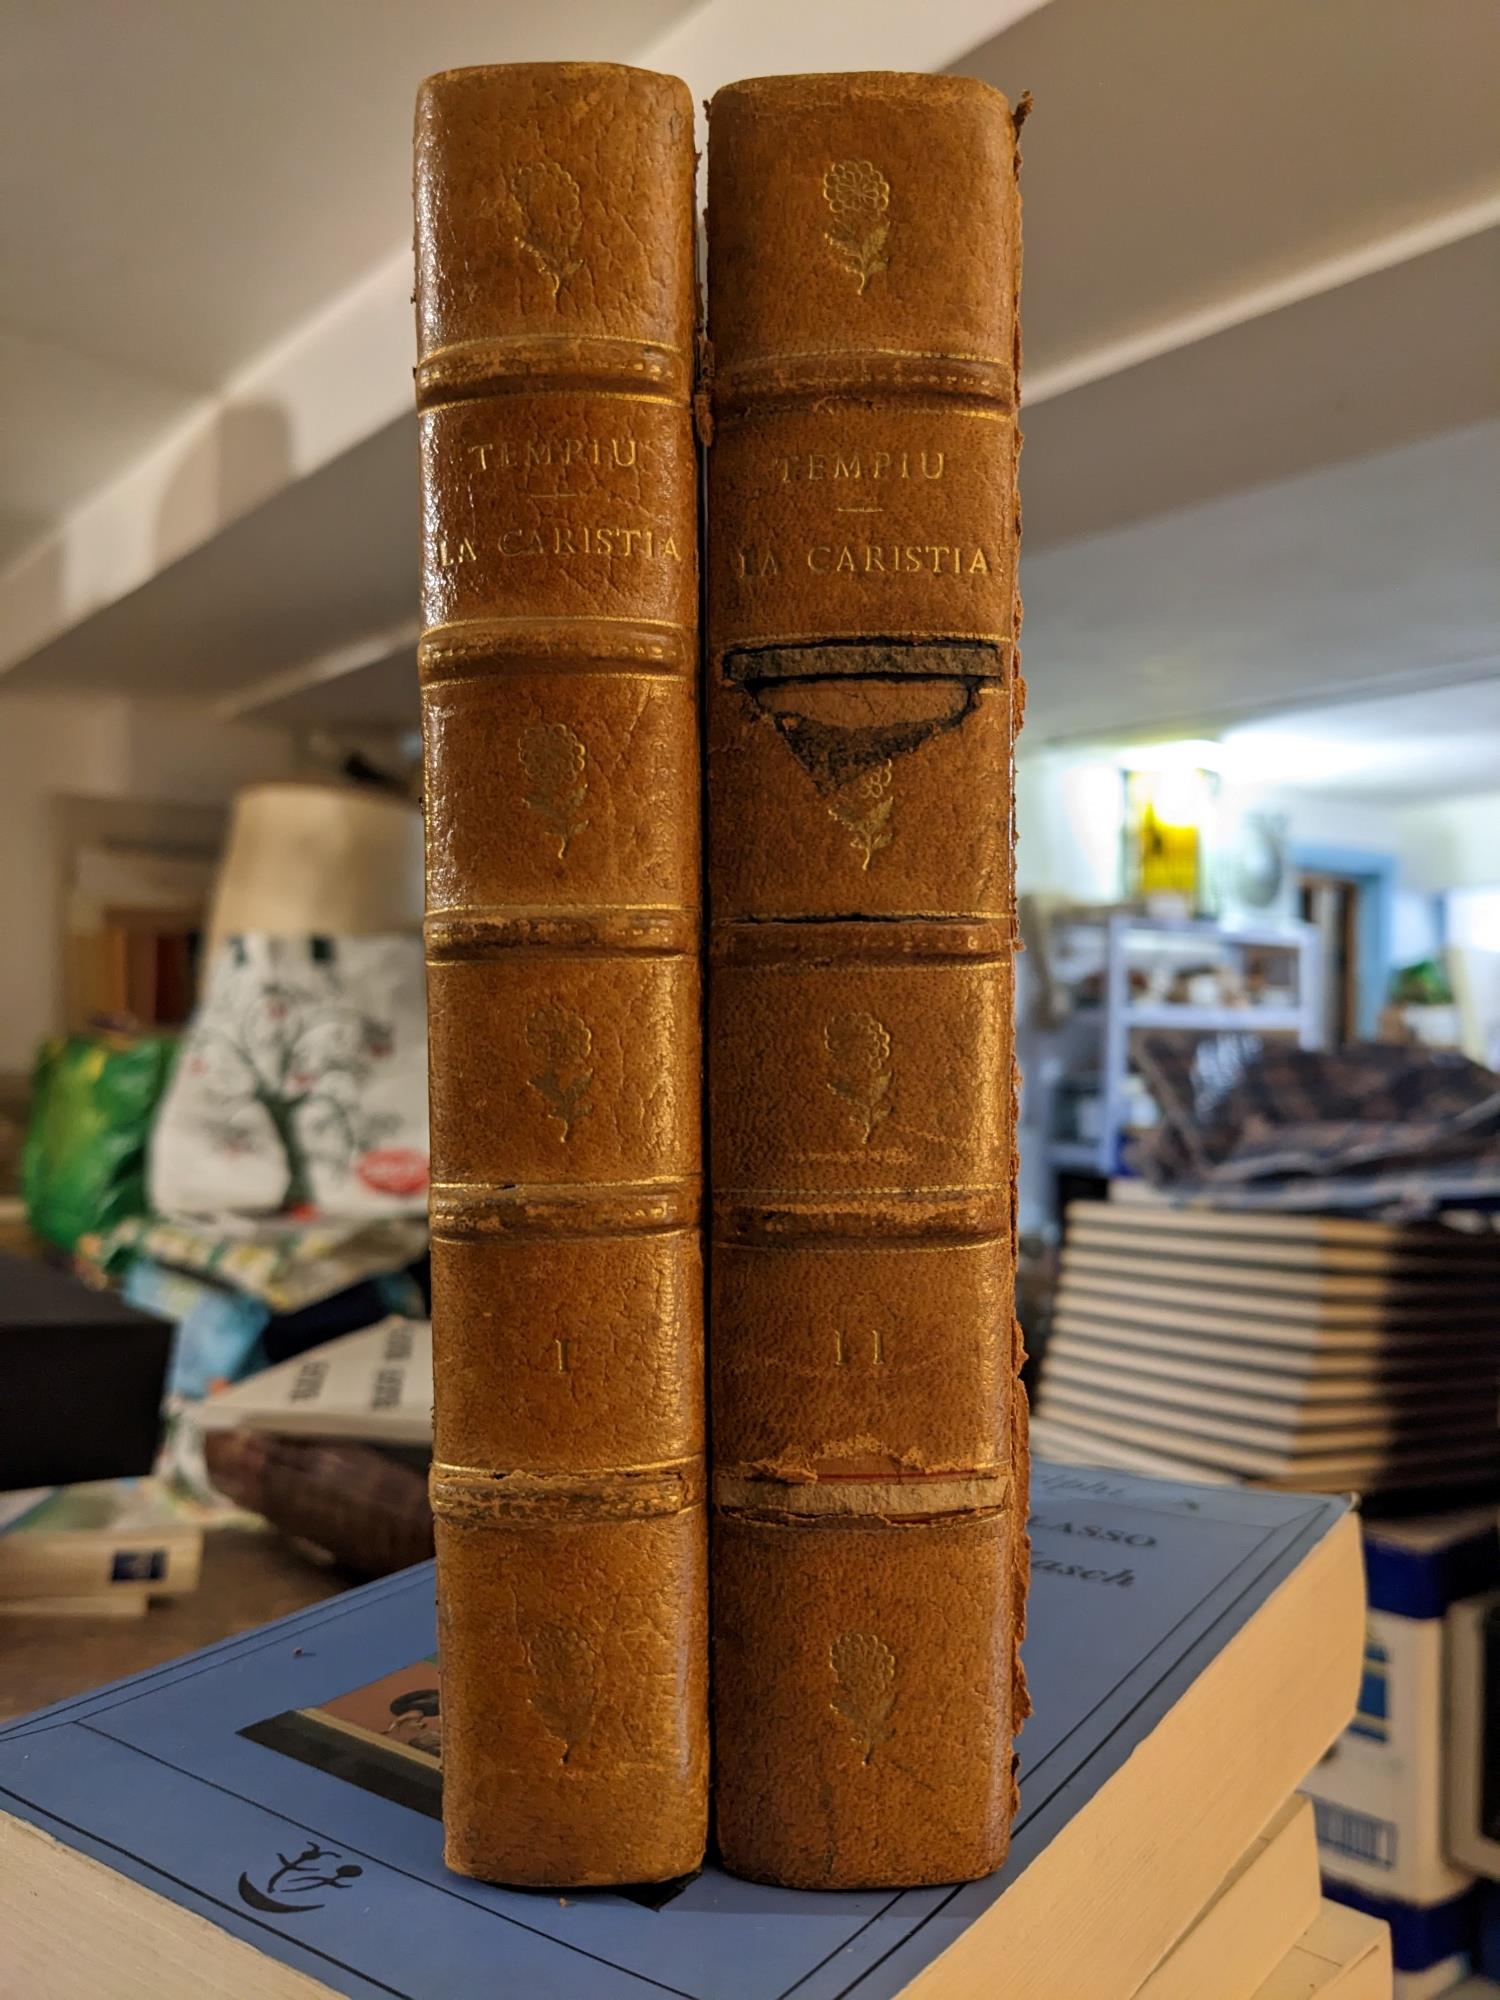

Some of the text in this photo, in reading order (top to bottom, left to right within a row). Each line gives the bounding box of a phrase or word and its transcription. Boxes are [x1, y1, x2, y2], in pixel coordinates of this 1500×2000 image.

[468, 438, 637, 471] TEMPIU
[774, 451, 945, 484] TEMPIU
[439, 526, 682, 567] LA CARISTIA
[806, 546, 990, 575] CARISTIA
[1030, 1551, 1136, 1587] asch
